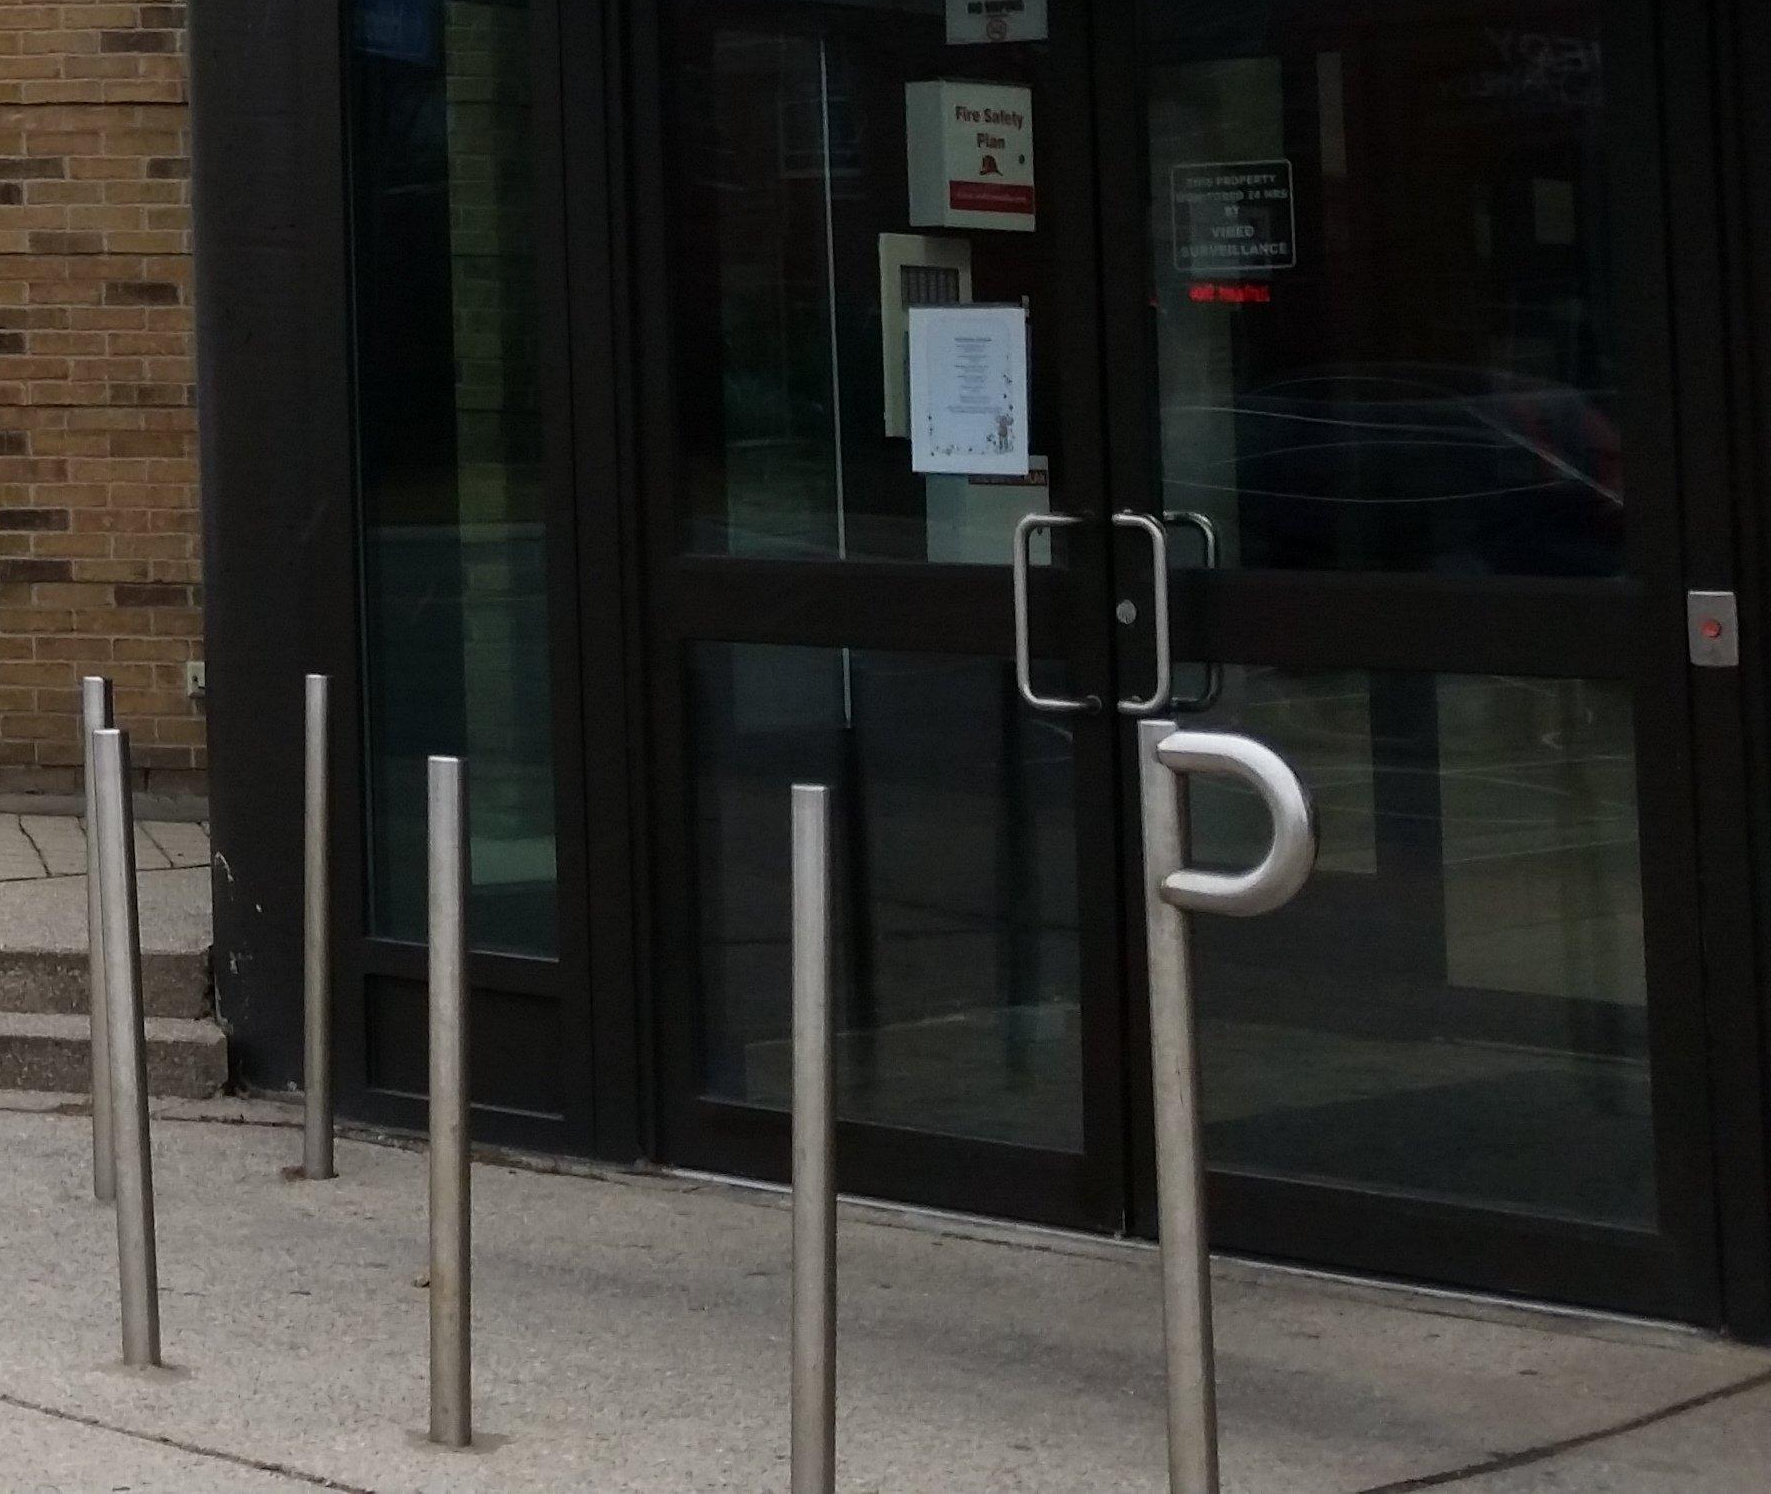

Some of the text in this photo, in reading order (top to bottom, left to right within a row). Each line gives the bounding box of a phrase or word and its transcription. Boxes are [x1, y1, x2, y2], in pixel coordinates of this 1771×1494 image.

[955, 105, 1024, 131] Fire Safety
[976, 133, 1006, 149] Plan
[1216, 174, 1277, 186] PROPERTY
[1179, 242, 1288, 258] SURVEILLANCE
